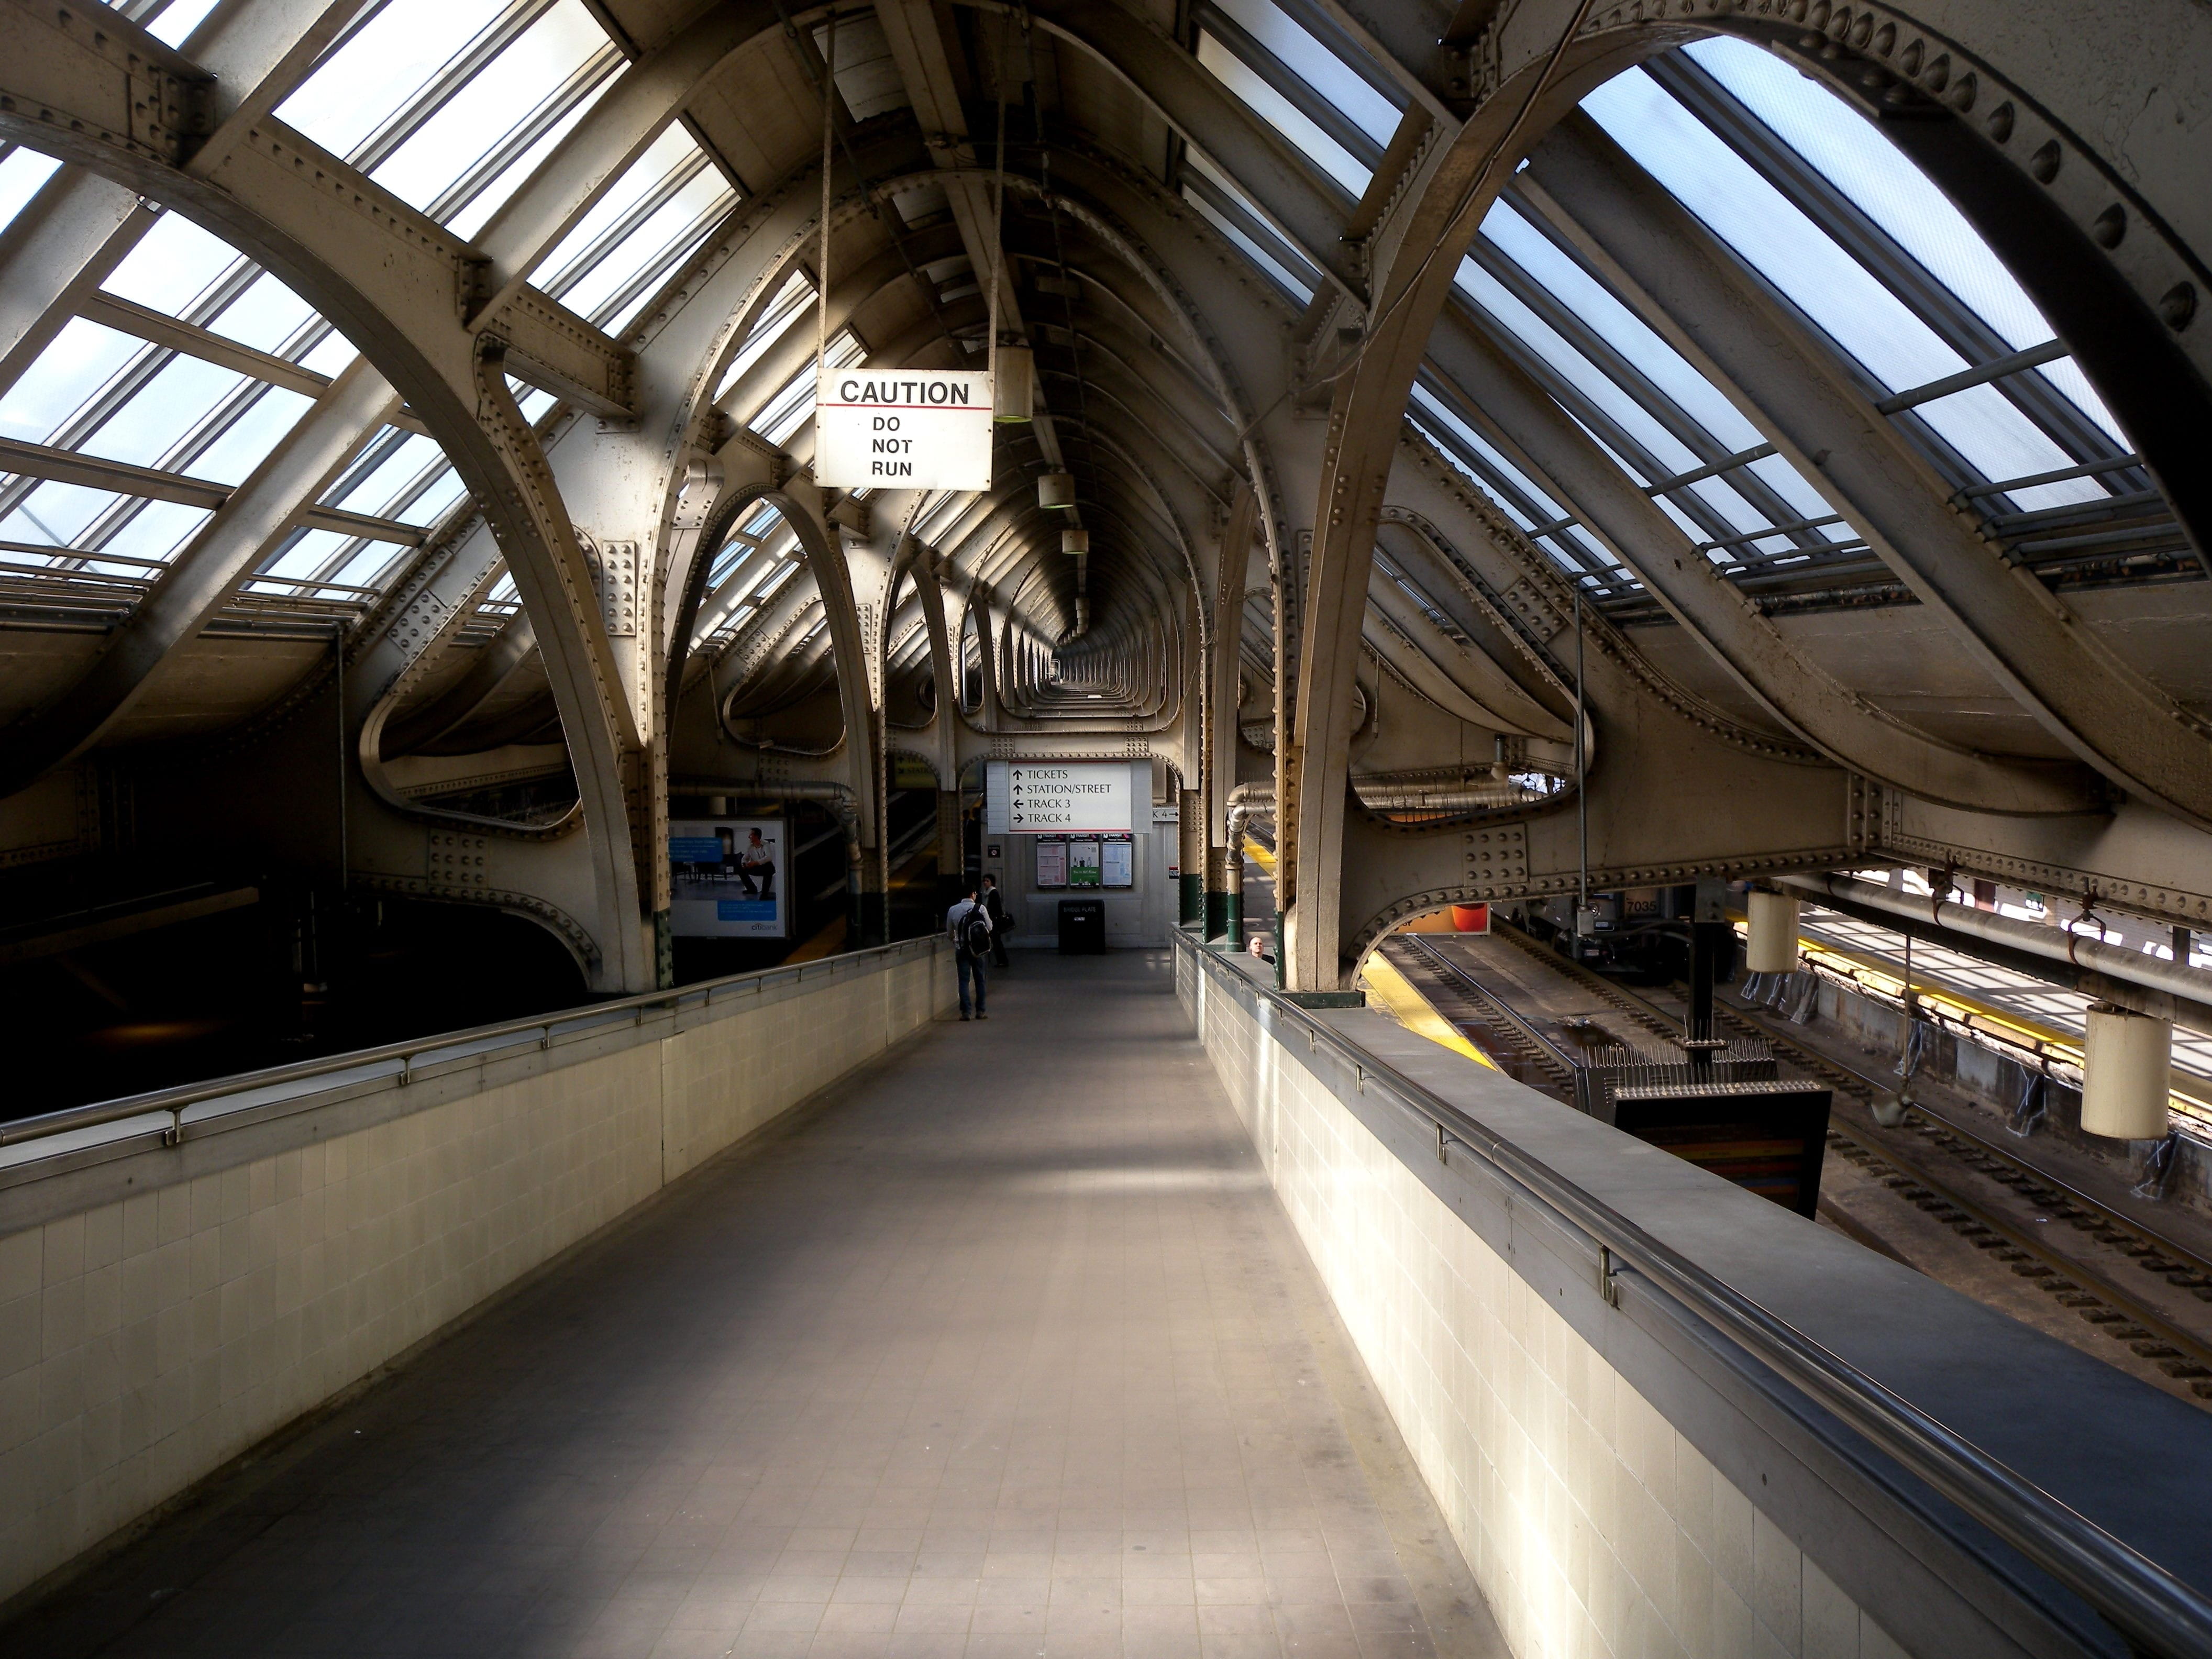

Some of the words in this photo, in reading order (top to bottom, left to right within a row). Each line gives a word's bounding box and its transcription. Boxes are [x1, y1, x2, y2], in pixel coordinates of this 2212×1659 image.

[840, 380, 969, 404] CAUTION
[873, 416, 900, 431] DO
[872, 439, 913, 454] NOT
[872, 461, 912, 476] RUN
[1027, 770, 1068, 779] TICKETS
[1027, 784, 1111, 794] STATION/STREET
[1027, 799, 1061, 808] TRACK
[1065, 799, 1070, 808] 3
[1027, 813, 1062, 822] TRACK
[1065, 813, 1071, 822] 4
[1627, 901, 1656, 912] 7035
